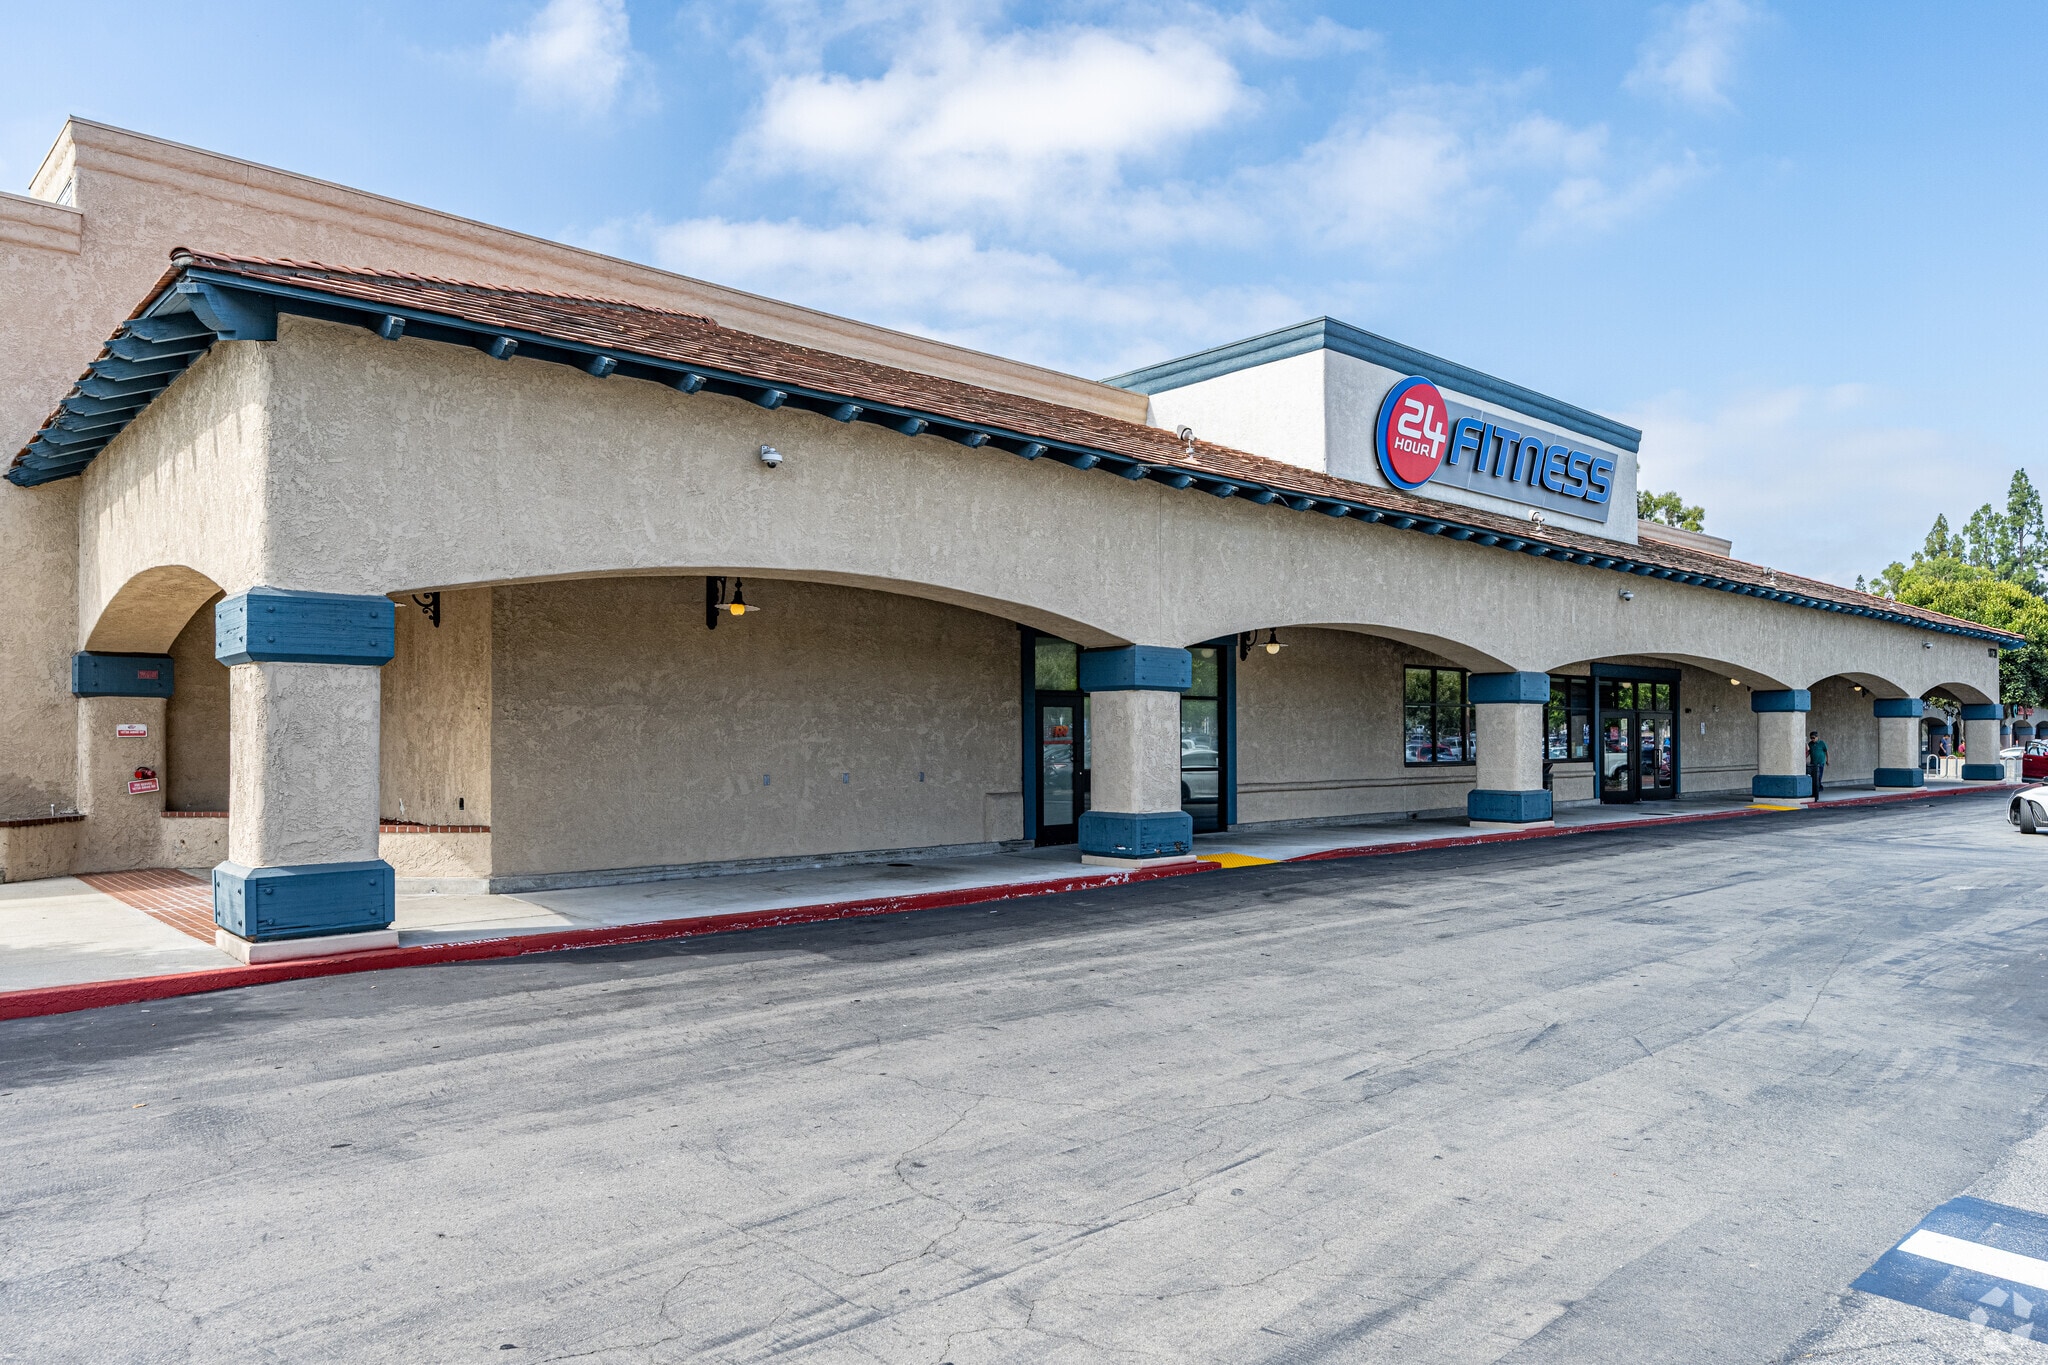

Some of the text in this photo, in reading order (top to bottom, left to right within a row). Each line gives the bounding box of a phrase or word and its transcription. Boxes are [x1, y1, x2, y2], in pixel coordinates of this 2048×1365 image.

[1394, 436, 1430, 457] HOUR
[1397, 398, 1447, 459] 24
[1450, 416, 1615, 504] FITNESS
